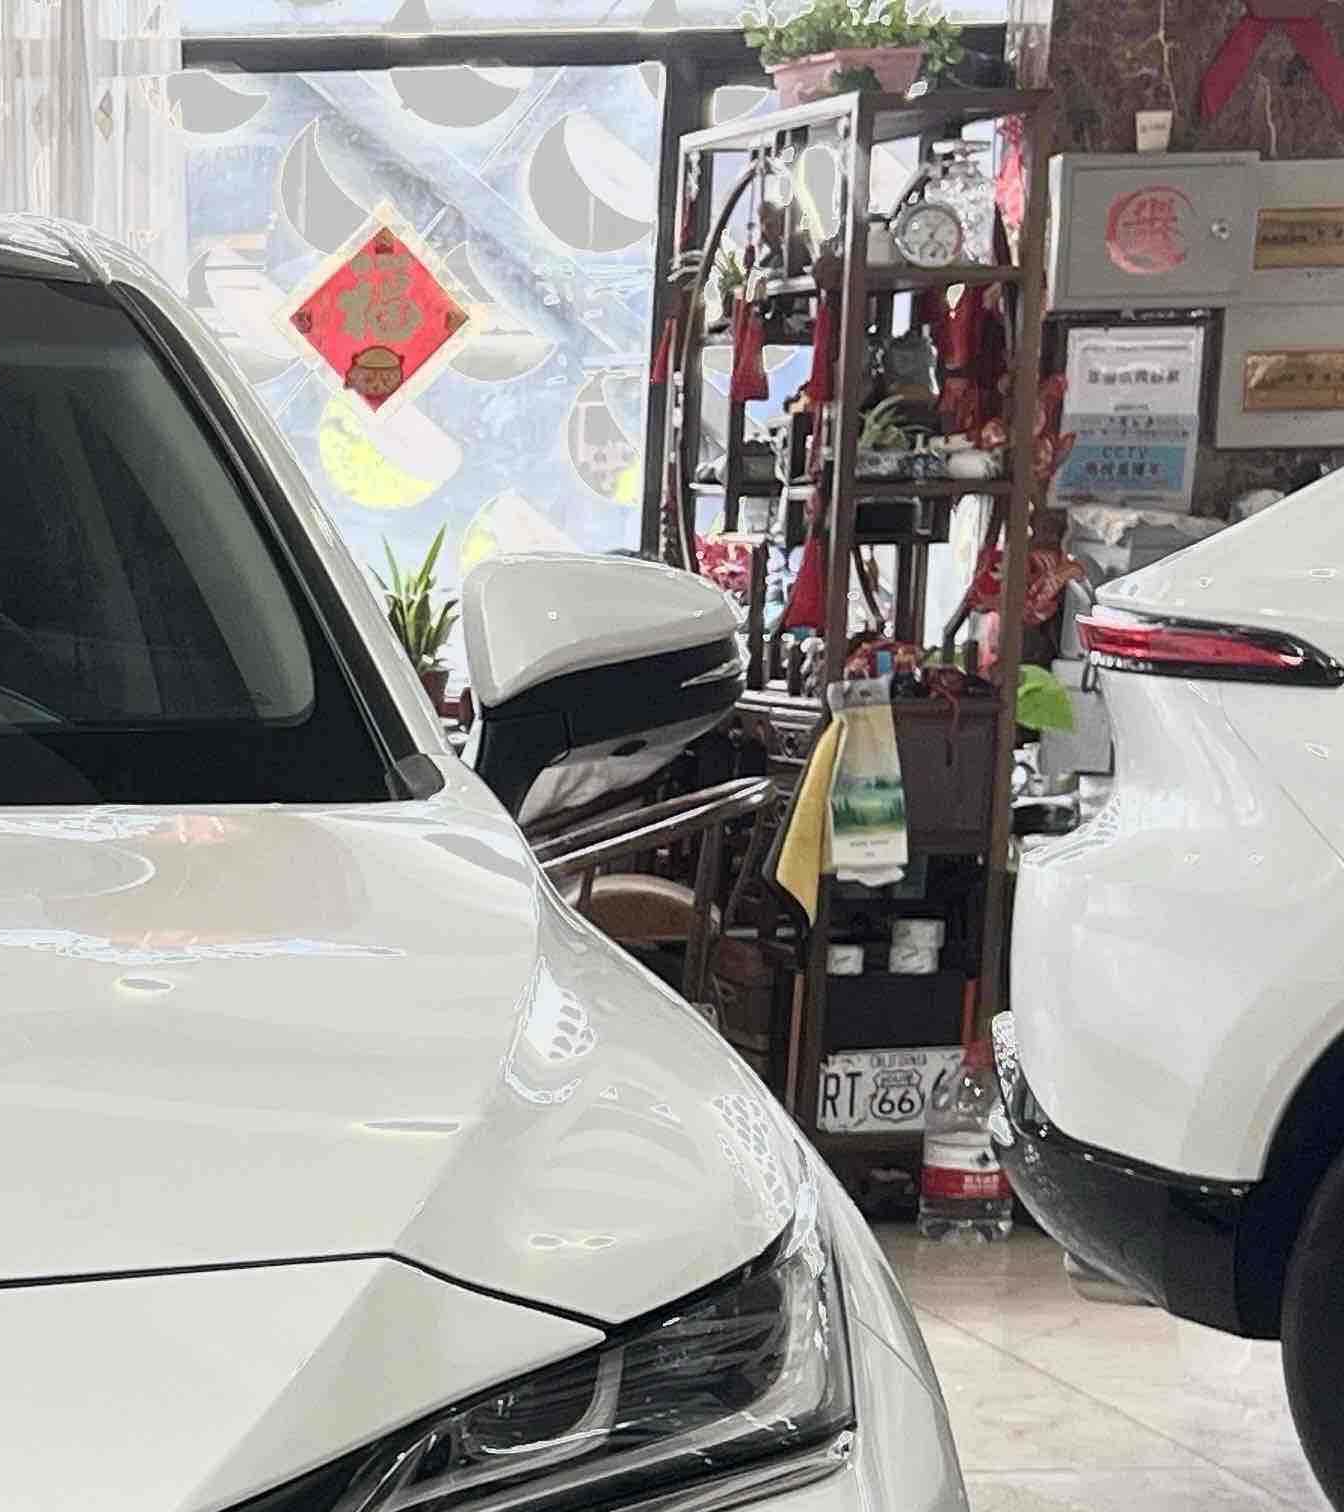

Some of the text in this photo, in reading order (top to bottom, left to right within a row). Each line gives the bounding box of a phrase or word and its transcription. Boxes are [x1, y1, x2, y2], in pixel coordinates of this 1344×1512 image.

[338, 252, 423, 341] 福
[822, 1071, 862, 1118] RT
[878, 1087, 915, 1114] 66
